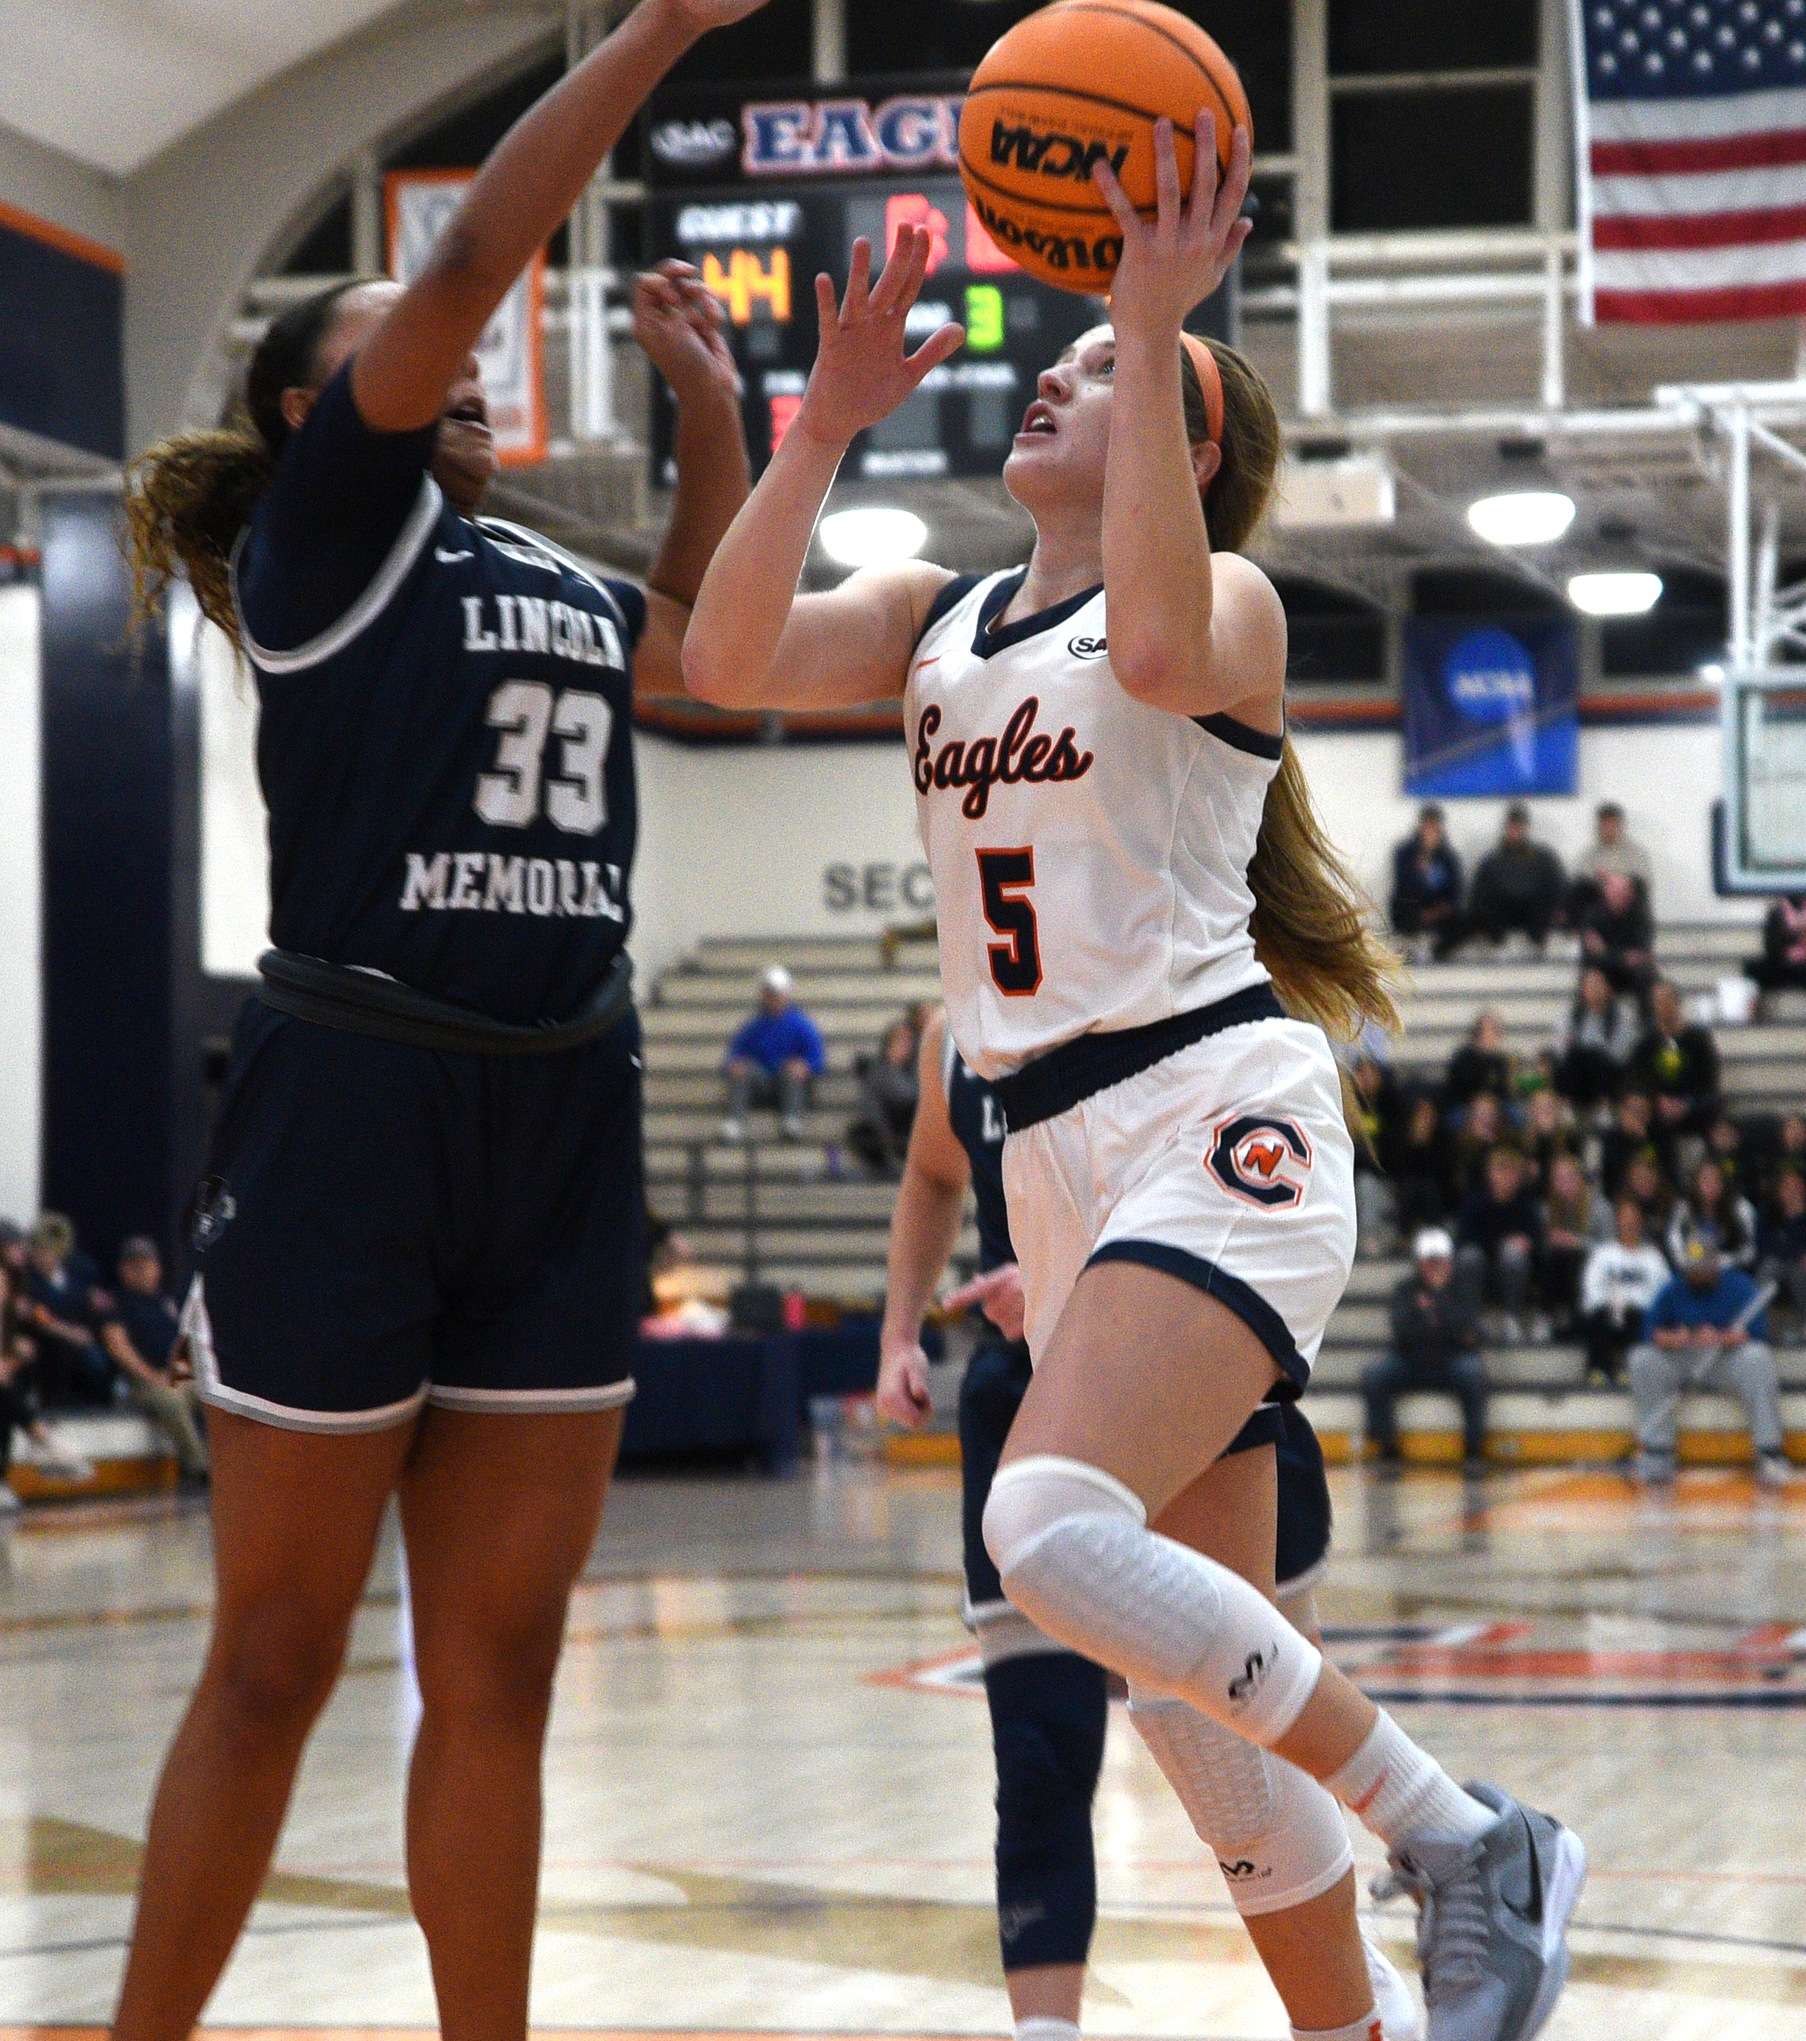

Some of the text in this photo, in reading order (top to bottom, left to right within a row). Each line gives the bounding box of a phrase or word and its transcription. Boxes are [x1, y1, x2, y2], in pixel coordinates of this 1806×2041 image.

[990, 116, 1131, 182] NCAA
[703, 248, 791, 324] 44
[965, 281, 1003, 350] 3
[471, 677, 614, 838] 33
[915, 695, 1095, 820] Eagles
[975, 845, 1044, 997] 5
